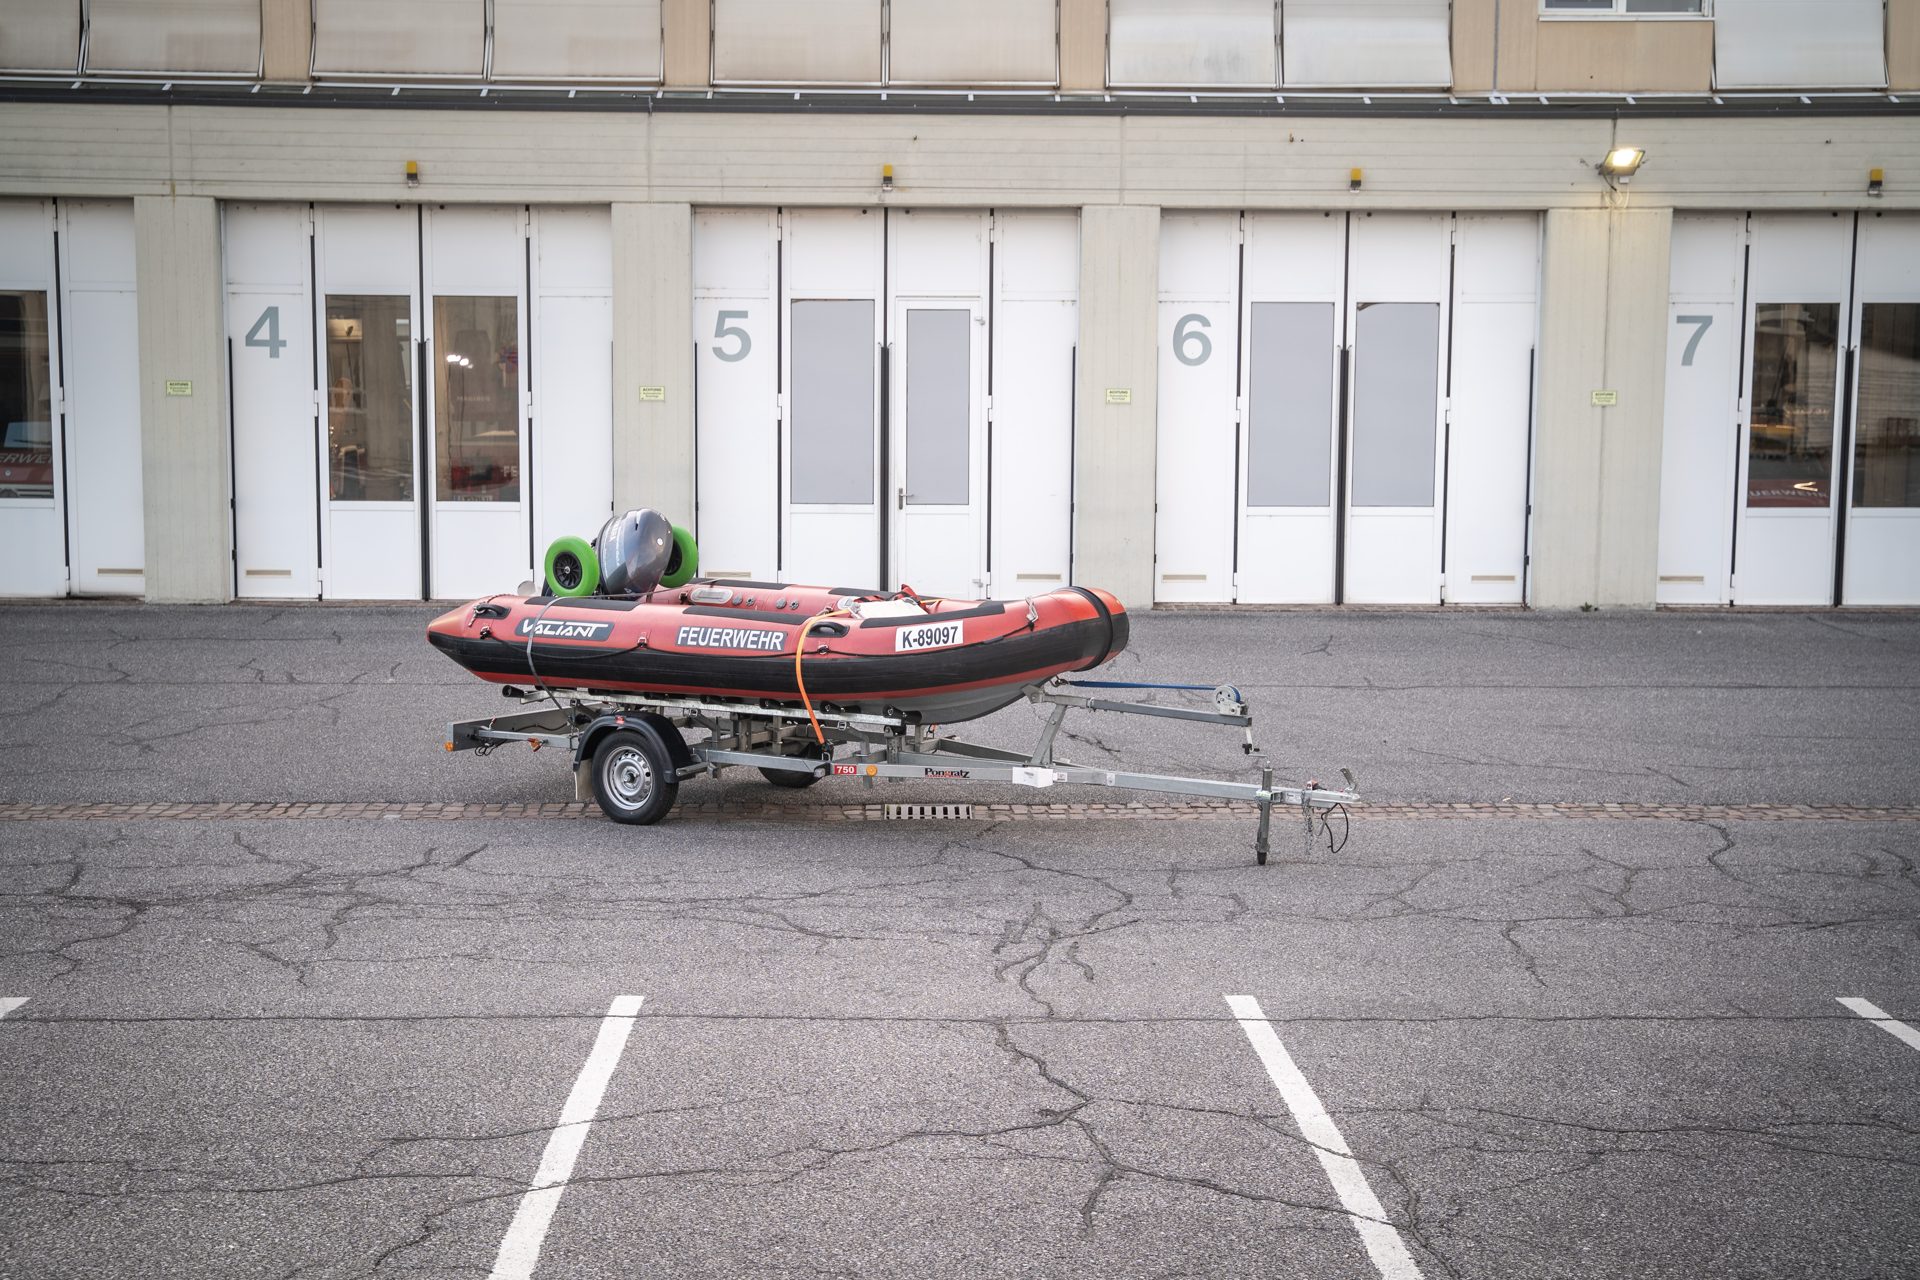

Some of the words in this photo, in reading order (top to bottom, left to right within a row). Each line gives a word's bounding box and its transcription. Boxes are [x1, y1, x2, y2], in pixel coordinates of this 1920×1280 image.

[246, 307, 286, 357] 4
[712, 311, 751, 361] 5
[1173, 314, 1211, 365] 6
[1677, 316, 1713, 366] 7
[522, 619, 608, 637] VALIANT
[677, 626, 784, 651] FEUERWEHR
[902, 626, 959, 648] K-89097
[836, 765, 855, 774] 750
[924, 767, 970, 778] Pongratz
